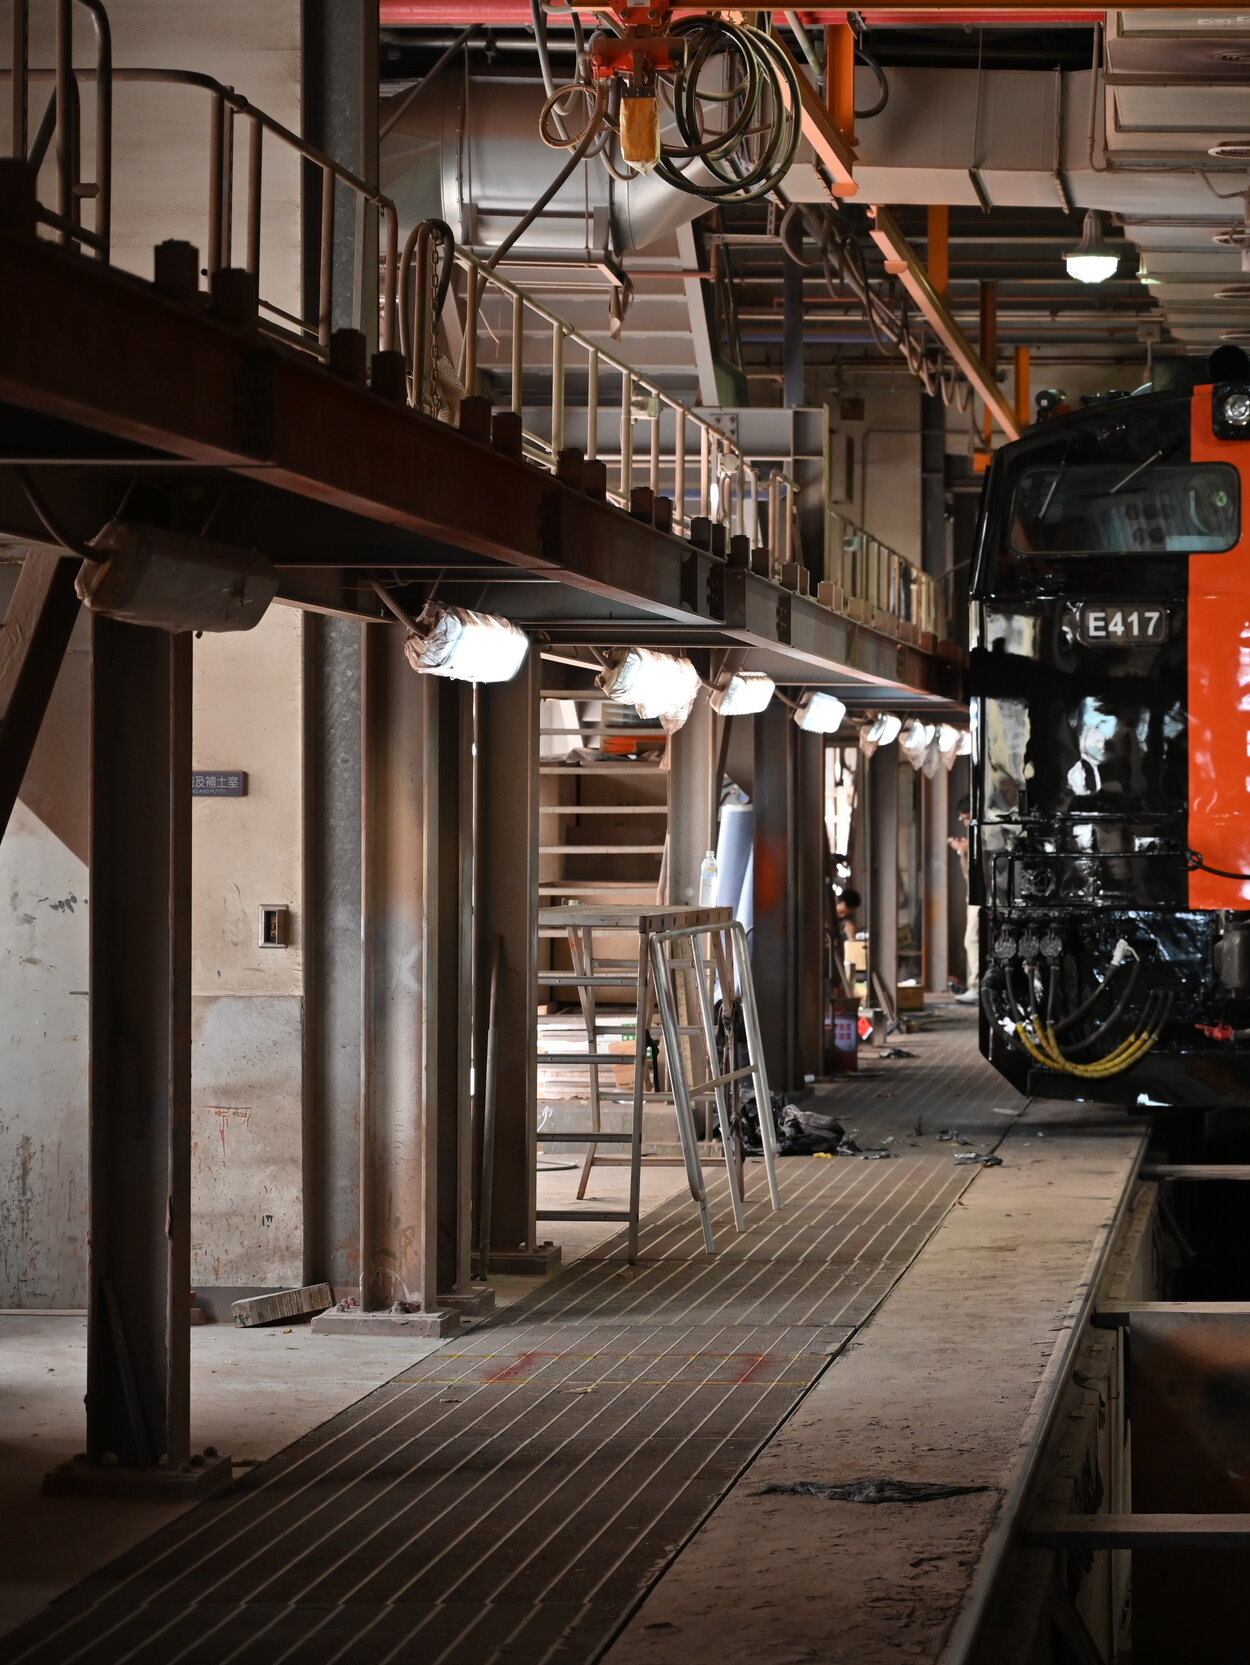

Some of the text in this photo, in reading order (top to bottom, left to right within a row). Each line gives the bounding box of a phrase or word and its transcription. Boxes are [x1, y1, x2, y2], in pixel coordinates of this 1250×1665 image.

[1088, 611, 1161, 637] E417
[192, 775, 239, 789] 及補土室
